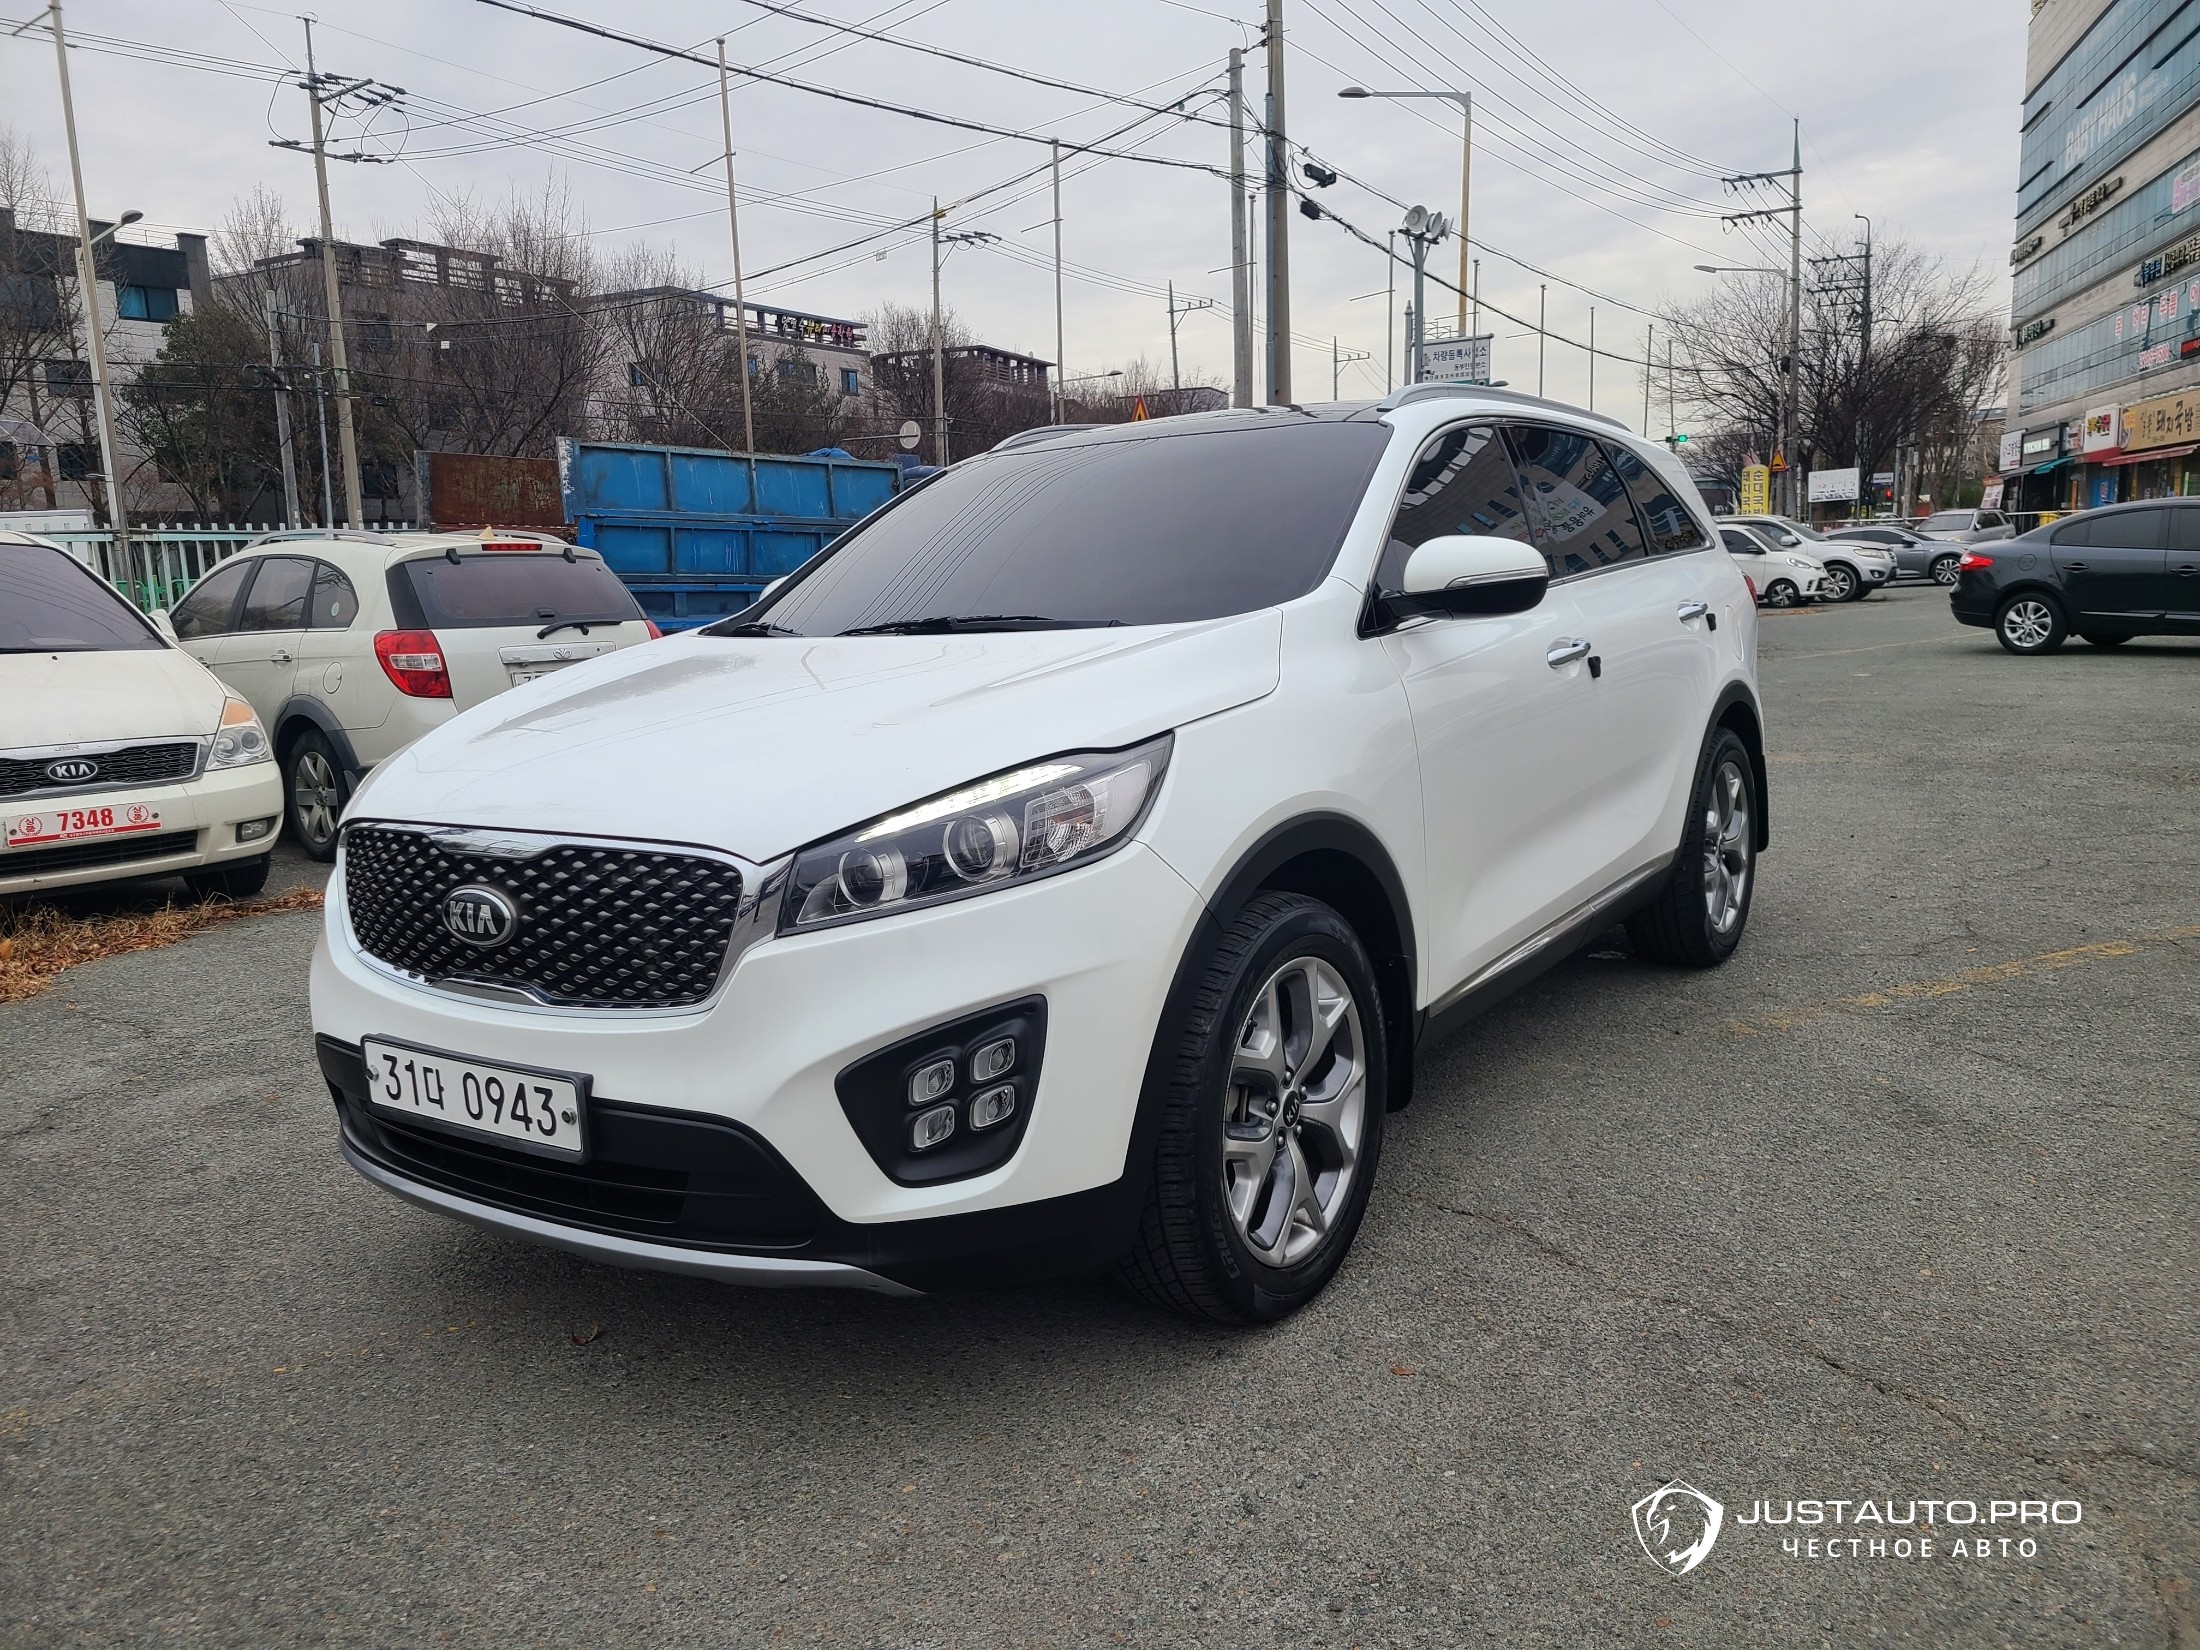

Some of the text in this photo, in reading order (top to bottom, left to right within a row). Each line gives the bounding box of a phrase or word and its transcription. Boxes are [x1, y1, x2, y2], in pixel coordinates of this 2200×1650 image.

[2065, 106, 2098, 170] BABY
[2097, 72, 2138, 146] HAUS
[55, 763, 91, 778] KIA
[57, 808, 113, 831] 7348
[450, 900, 498, 935] KIA
[382, 1053, 557, 1137] 31마 0943
[1286, 1098, 1300, 1123] KIA
